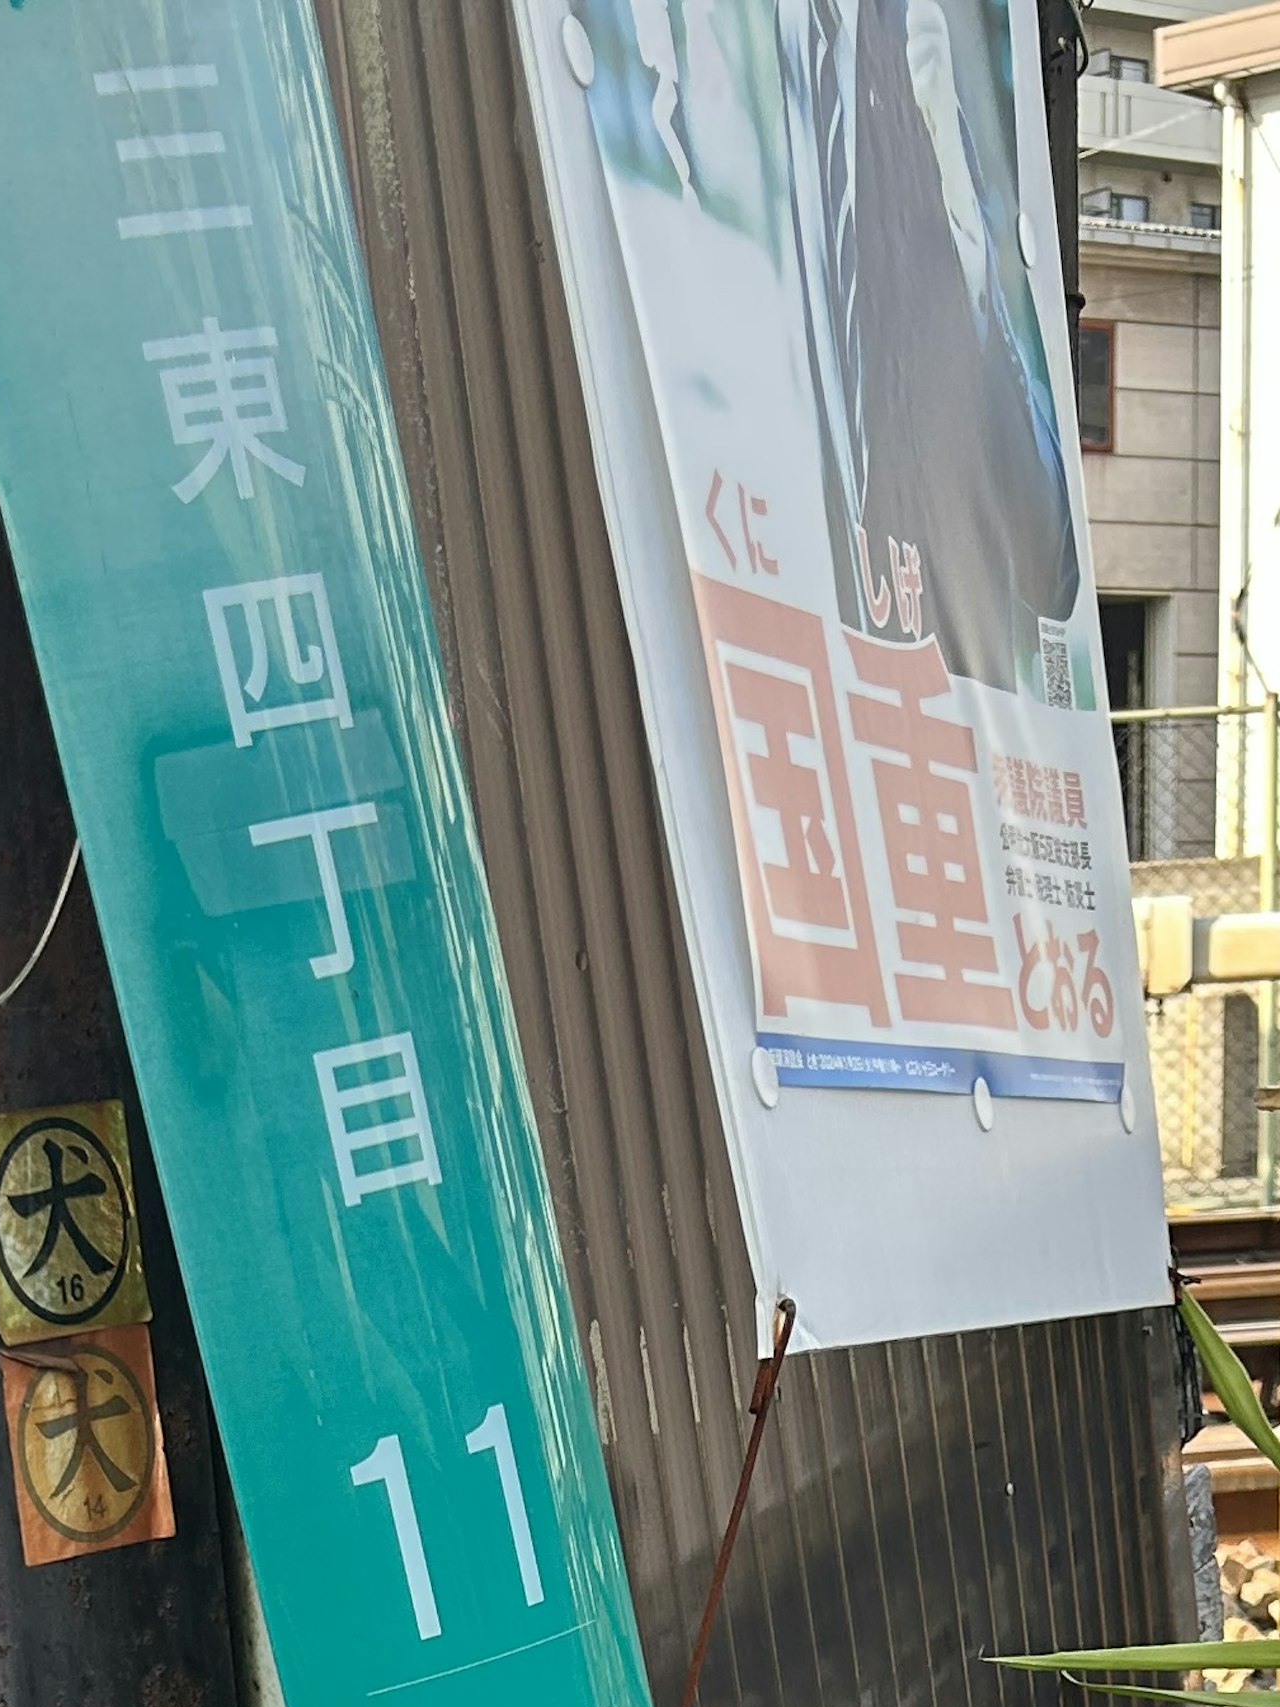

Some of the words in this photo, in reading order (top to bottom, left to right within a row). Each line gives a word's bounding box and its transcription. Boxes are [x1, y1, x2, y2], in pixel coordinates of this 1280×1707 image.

[705, 467, 779, 576] くに
[856, 524, 923, 641] しげ
[1014, 911, 1114, 1039] とおる
[7, 1139, 115, 1278] 犬
[56, 1275, 84, 1305] 16
[36, 1366, 140, 1499] 犬
[82, 1494, 107, 1519] 14
[349, 1403, 546, 1642] 11
